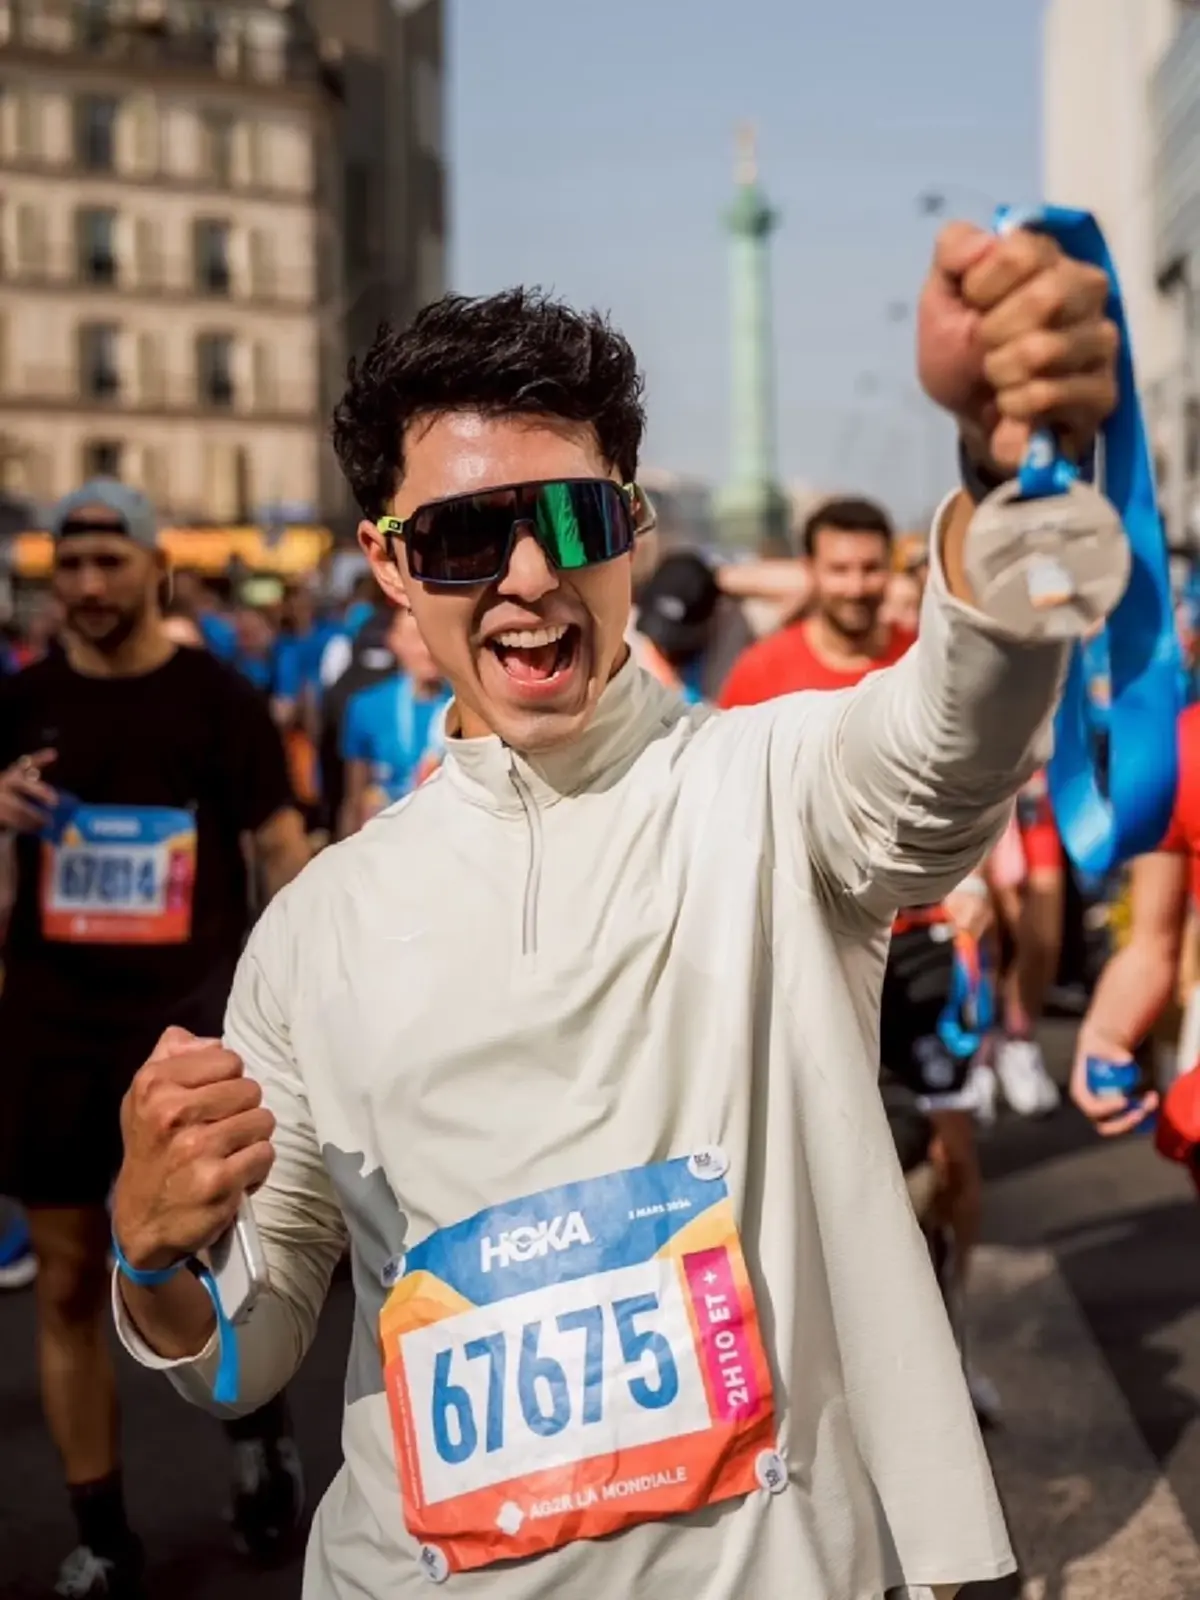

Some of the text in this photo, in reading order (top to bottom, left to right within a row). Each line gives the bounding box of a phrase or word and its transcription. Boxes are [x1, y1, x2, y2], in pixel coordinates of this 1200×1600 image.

[635, 1203, 665, 1217] MARS
[480, 1210, 593, 1273] HOKA
[704, 1293, 732, 1324] ET
[432, 1291, 679, 1465] 67675
[529, 1465, 687, 1521] AG2R LA MONDIALE
